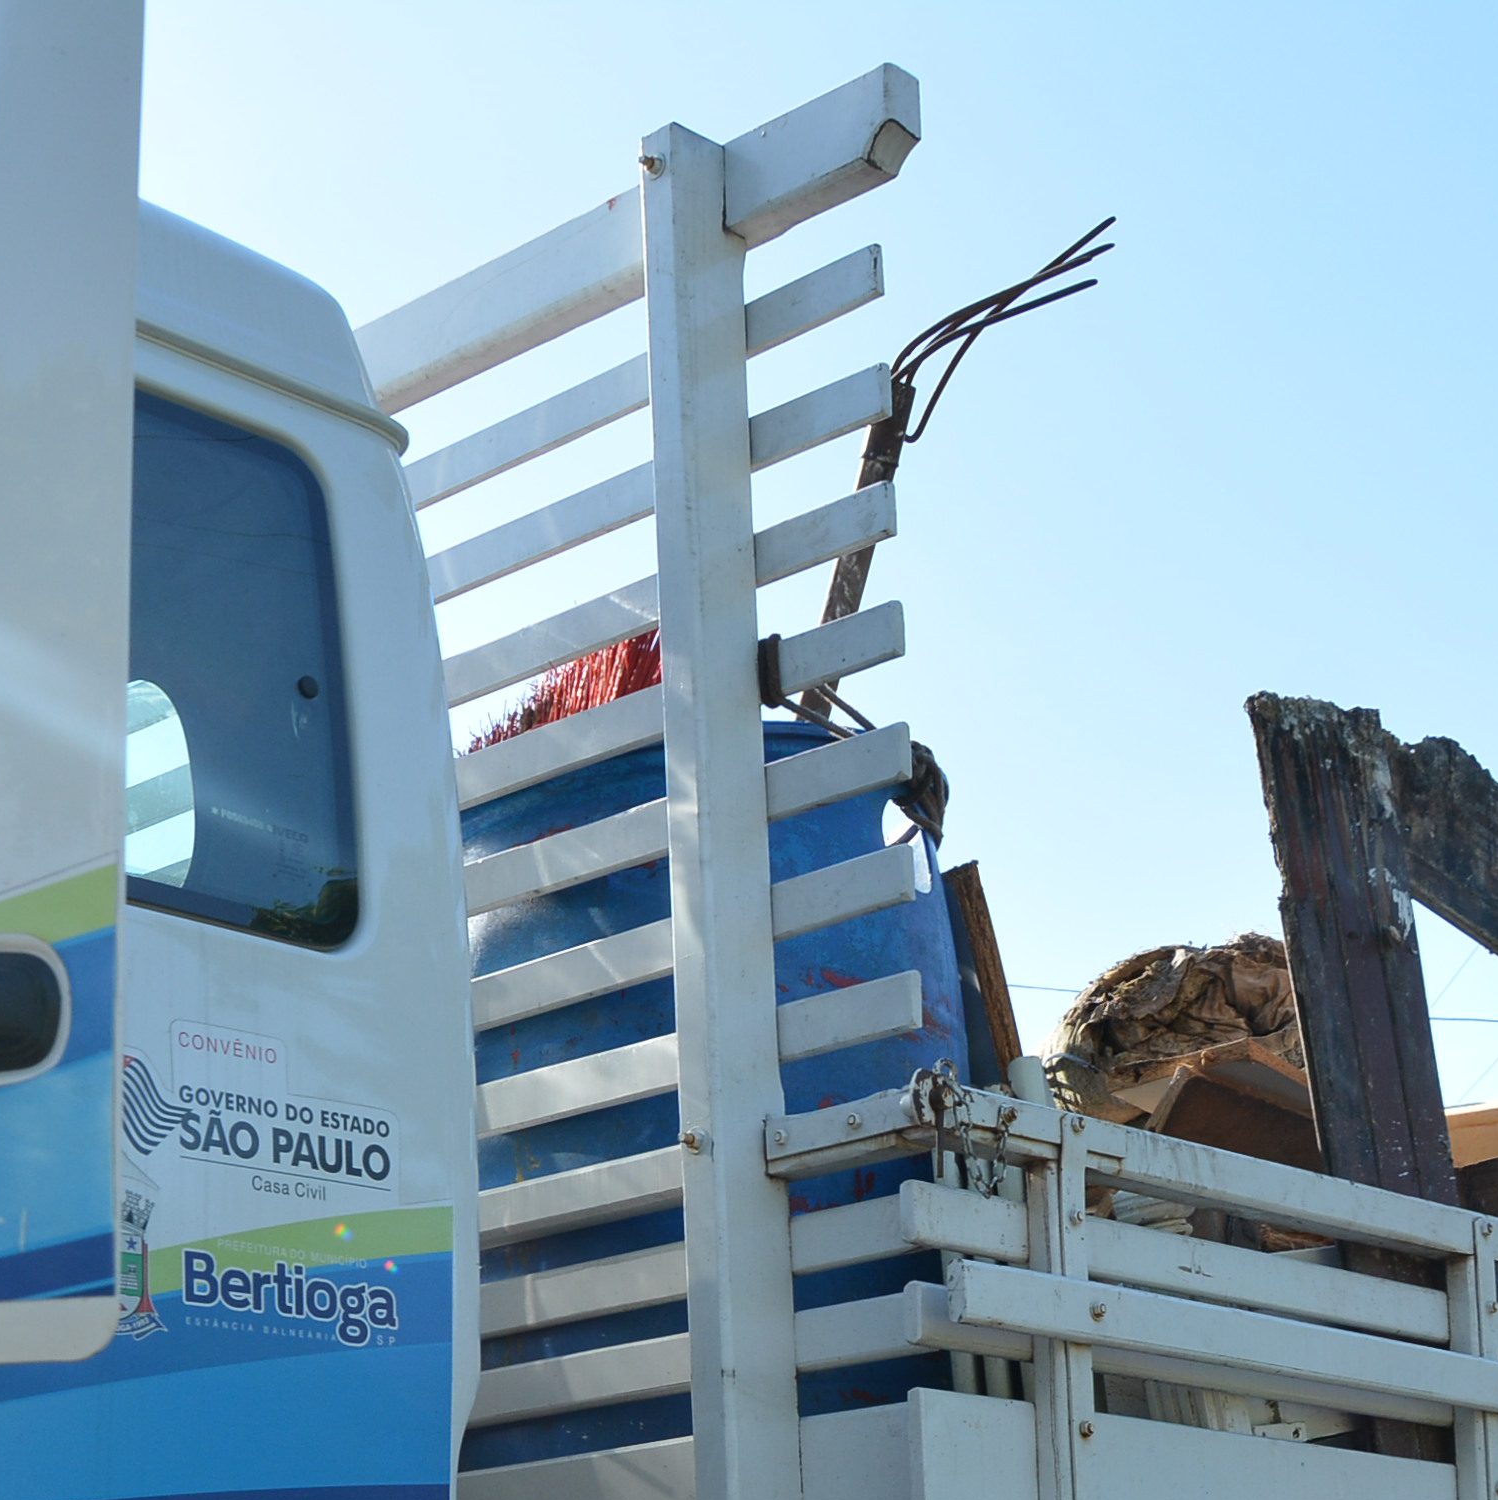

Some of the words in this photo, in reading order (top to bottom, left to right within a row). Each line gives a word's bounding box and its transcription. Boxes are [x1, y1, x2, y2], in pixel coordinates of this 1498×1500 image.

[178, 1032, 278, 1063] CONVÊNIO
[179, 1085, 278, 1118] GOVERNO
[285, 1103, 313, 1124] DO
[321, 1110, 390, 1138] ESTADO
[179, 1109, 260, 1159] SÃO
[272, 1127, 391, 1181] PAULO
[252, 1175, 290, 1196] Casa
[295, 1182, 327, 1201] Civil
[217, 1238, 288, 1259] PREFEITURA
[290, 1249, 307, 1261] DO
[311, 1251, 368, 1269] MUNICÍPIO
[183, 1248, 398, 1347] Bertioga
[185, 1316, 254, 1332] ESTÂNCIA
